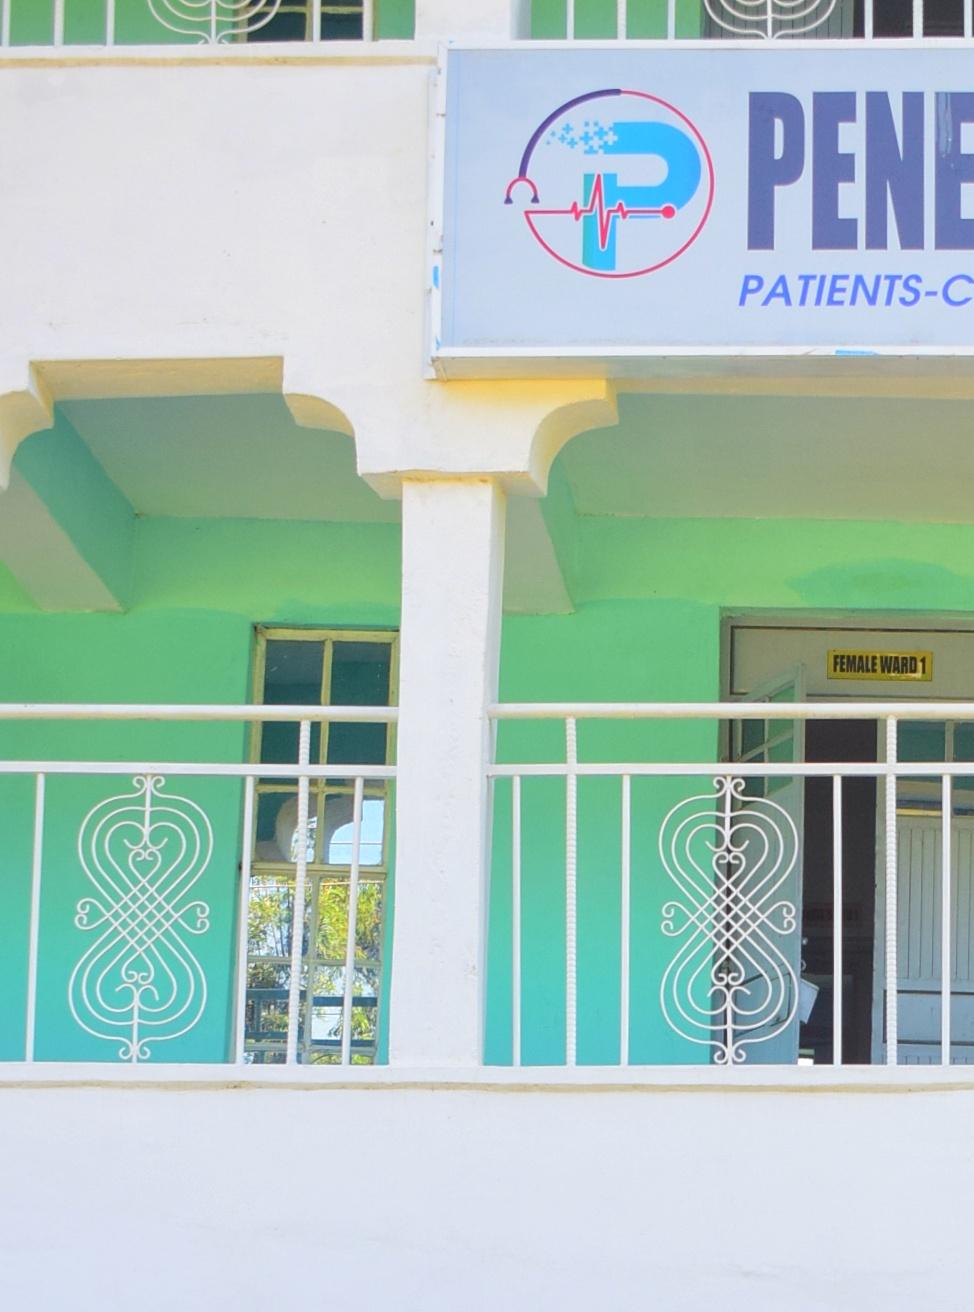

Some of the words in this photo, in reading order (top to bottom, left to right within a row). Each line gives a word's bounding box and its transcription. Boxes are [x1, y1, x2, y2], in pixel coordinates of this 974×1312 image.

[833, 655, 877, 673] FEMALE
[881, 656, 918, 674] WARD
[920, 656, 926, 674] 1
